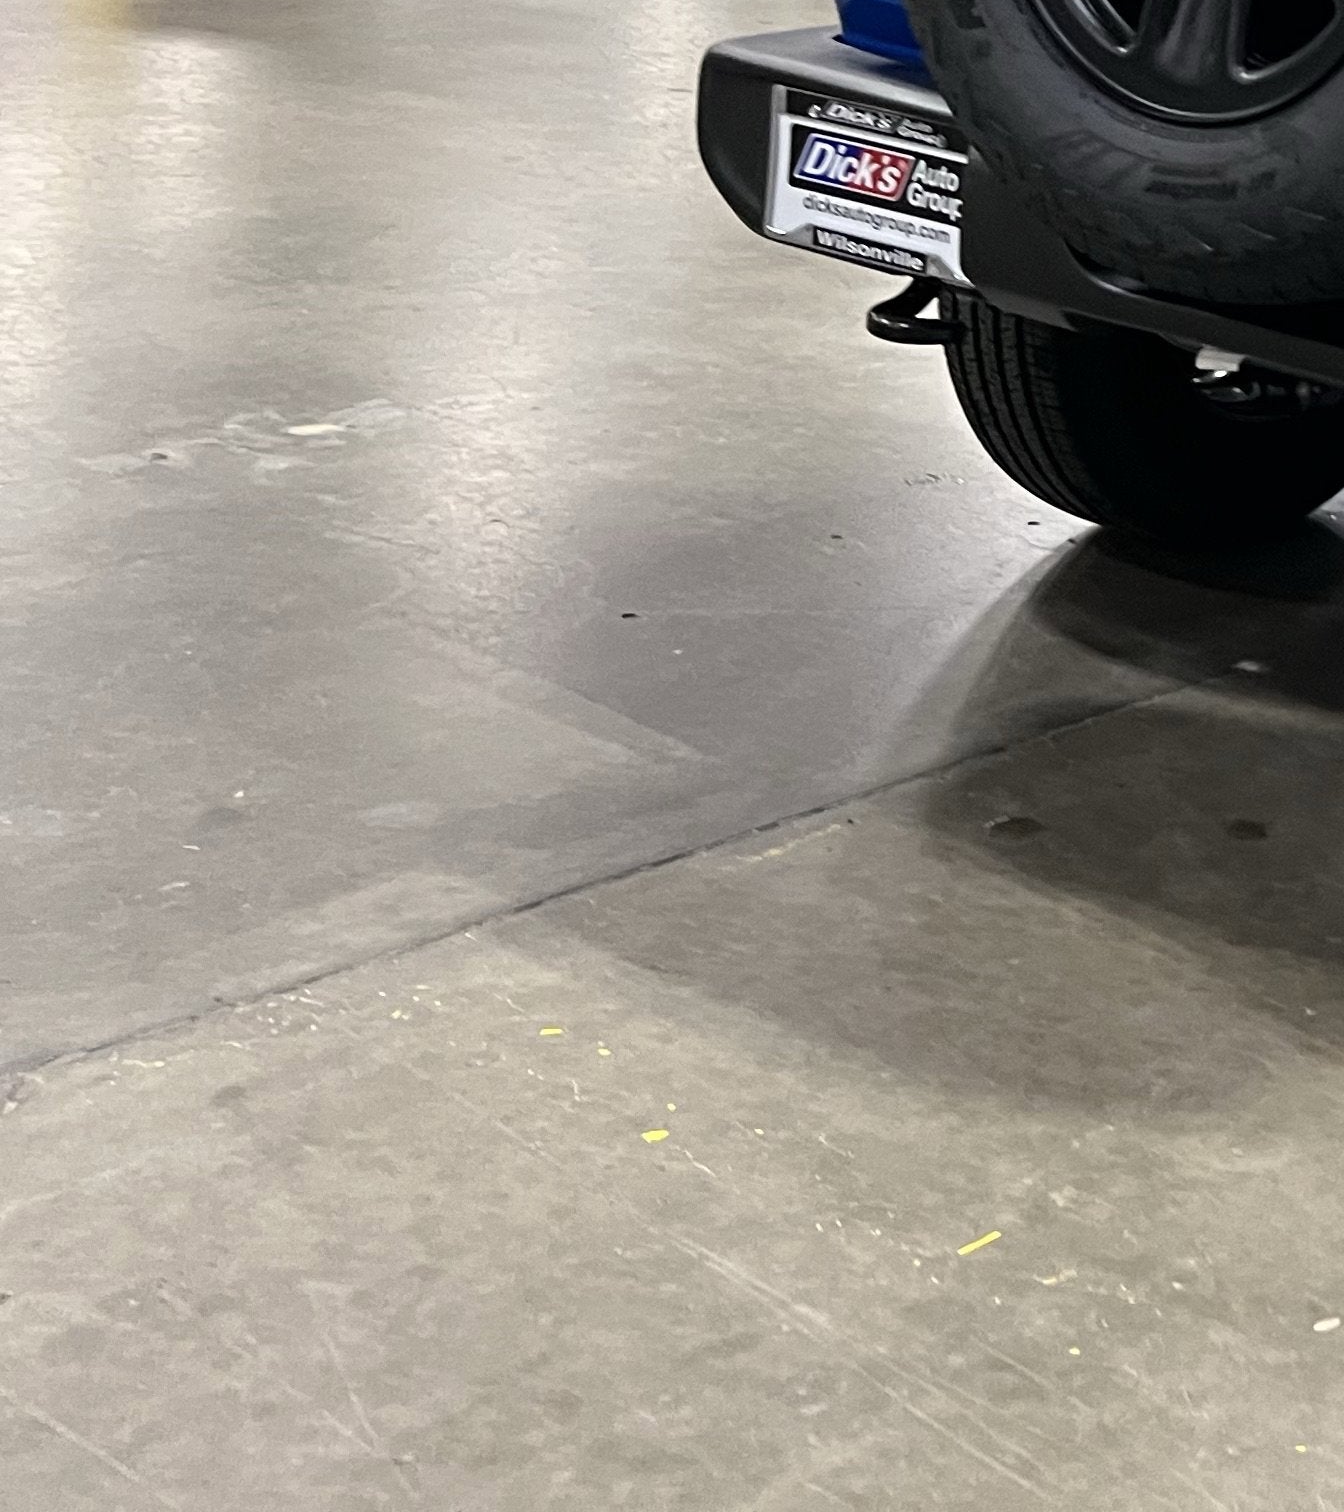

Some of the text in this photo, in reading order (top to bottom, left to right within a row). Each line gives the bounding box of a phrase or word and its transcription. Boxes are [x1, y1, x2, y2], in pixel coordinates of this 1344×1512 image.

[803, 140, 901, 194] Dick's
[912, 159, 960, 192] Auto
[802, 194, 951, 245] dicksautogroup.com
[906, 182, 964, 222] Group
[815, 229, 925, 271] Wilsonville
